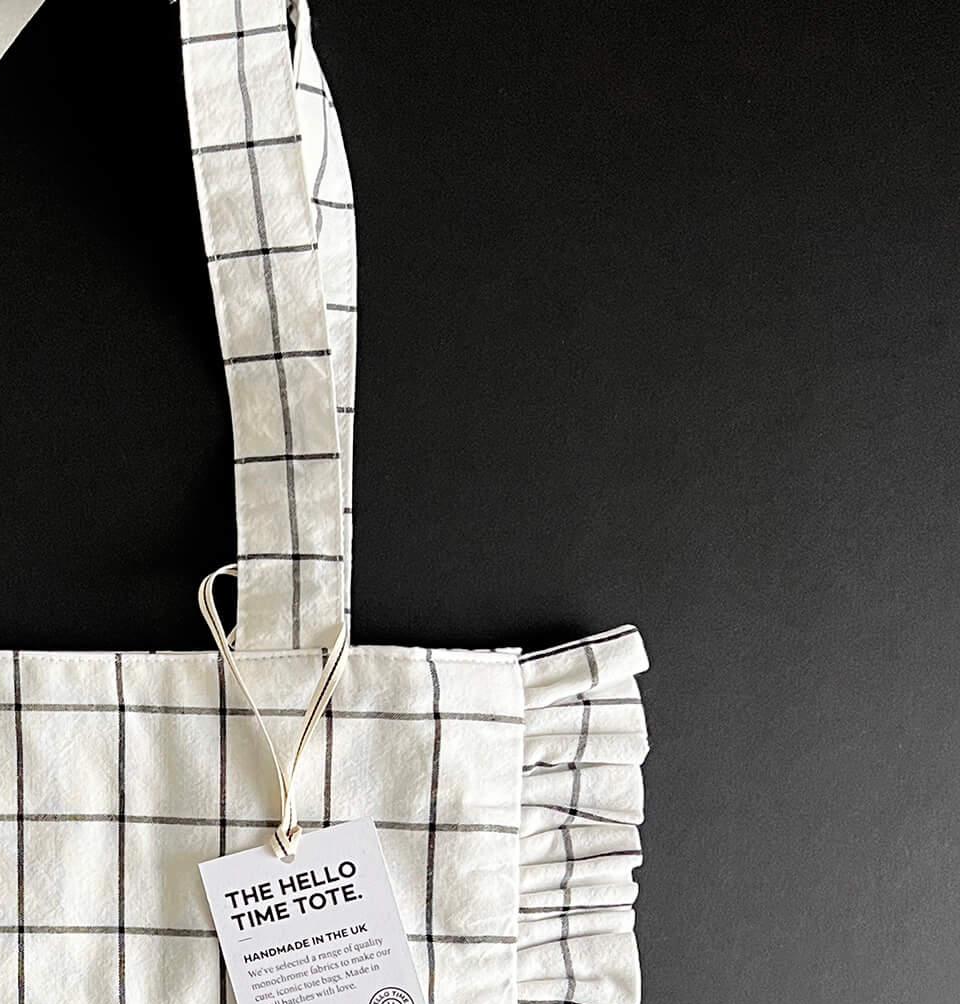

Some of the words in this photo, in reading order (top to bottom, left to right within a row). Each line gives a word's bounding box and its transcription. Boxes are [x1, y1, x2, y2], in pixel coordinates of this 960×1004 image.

[224, 882, 274, 909] THE
[278, 861, 356, 895] HELLO
[231, 902, 290, 931] TIME
[293, 883, 363, 914] TOTE.
[243, 939, 310, 963] HANDMADE
[311, 935, 325, 946] IN
[325, 928, 349, 941] THE
[350, 923, 368, 935] UK
[248, 967, 274, 978] We've
[275, 955, 310, 971] selected
[318, 948, 342, 960] range
[343, 943, 353, 953] of
[353, 938, 383, 953] quality
[252, 970, 309, 990] monochrome
[310, 962, 340, 975] fabrics
[340, 960, 350, 968] to
[351, 952, 375, 964] make
[376, 948, 391, 958] our
[255, 992, 275, 1002] cute,
[276, 983, 303, 996] iconic
[303, 979, 320, 990] tote
[320, 973, 343, 985] bags.
[345, 965, 370, 979] Made
[371, 963, 380, 972] in
[315, 986, 336, 998] with
[336, 982, 357, 993] love.
[392, 991, 410, 1004] TIME
